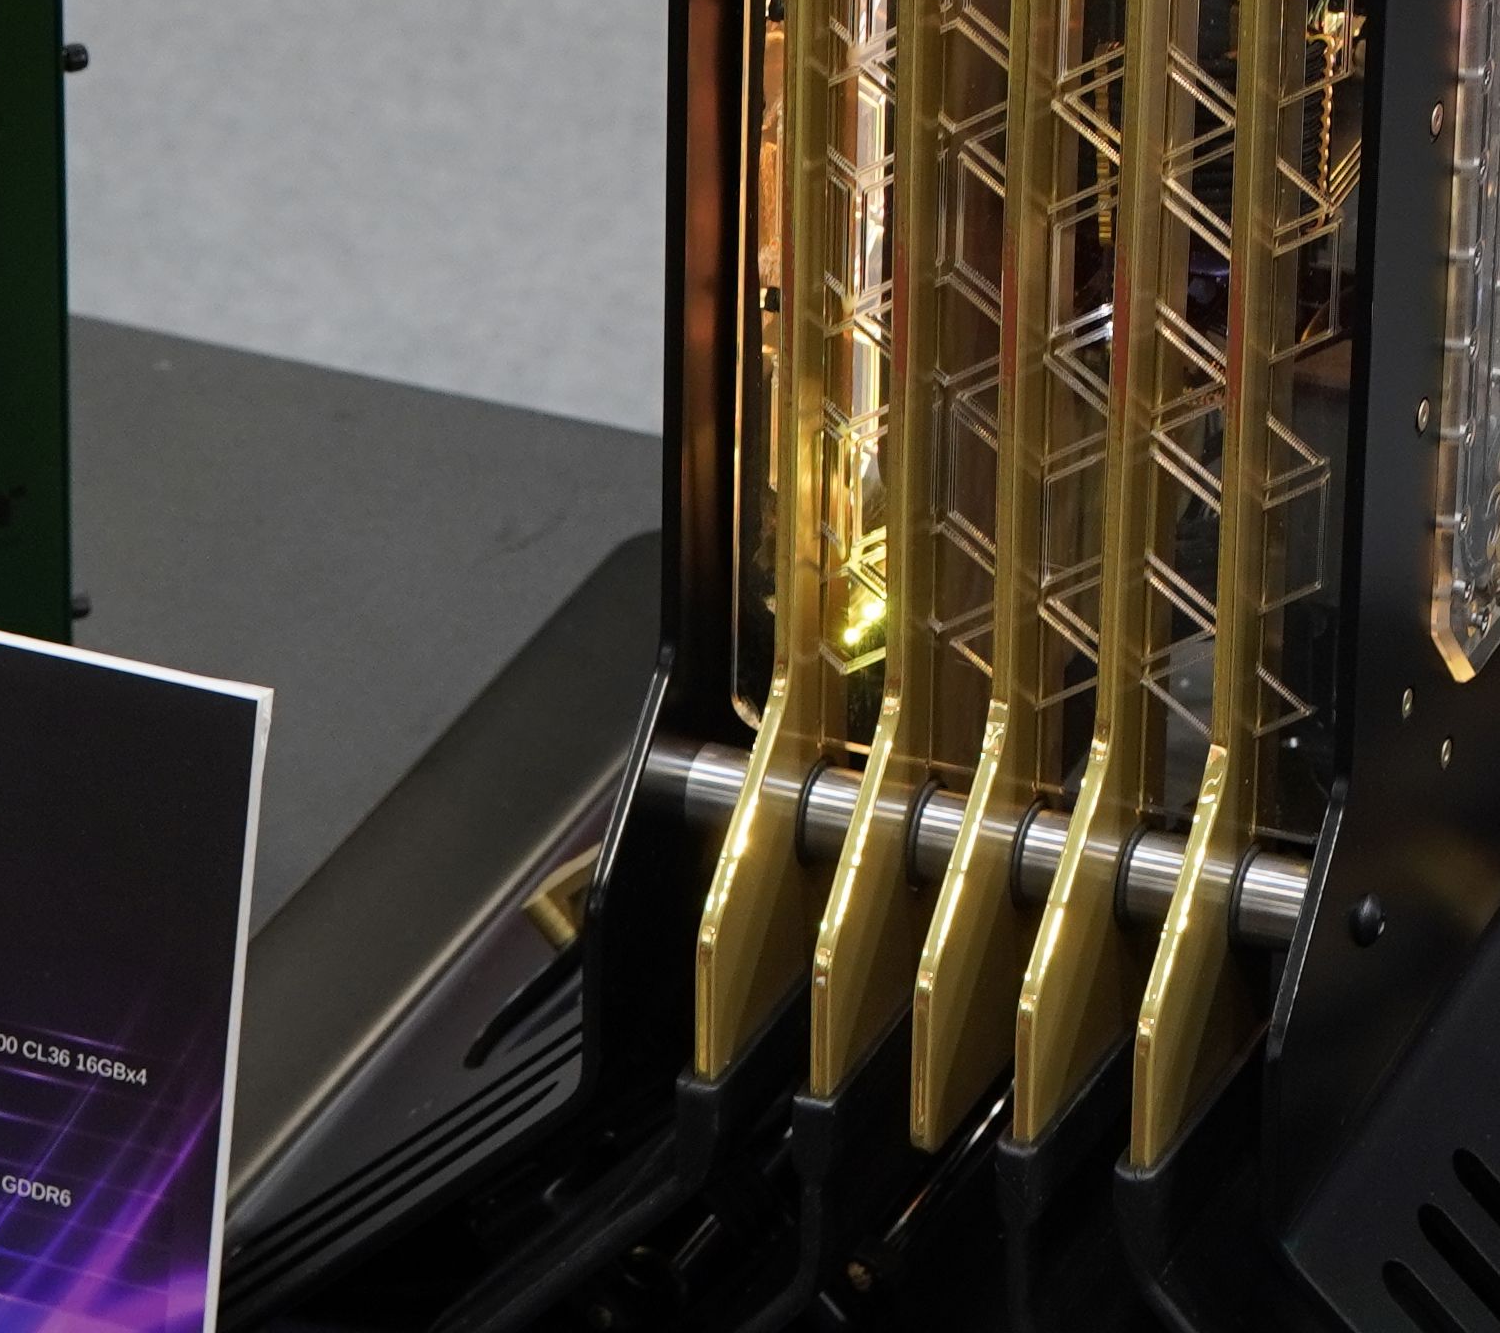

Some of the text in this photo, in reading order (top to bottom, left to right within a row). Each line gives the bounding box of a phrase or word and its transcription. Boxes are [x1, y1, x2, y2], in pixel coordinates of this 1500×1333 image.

[22, 1040, 70, 1067] CL36
[76, 1052, 148, 1086] 16GBx4
[2, 1175, 72, 1208] GDDR6
